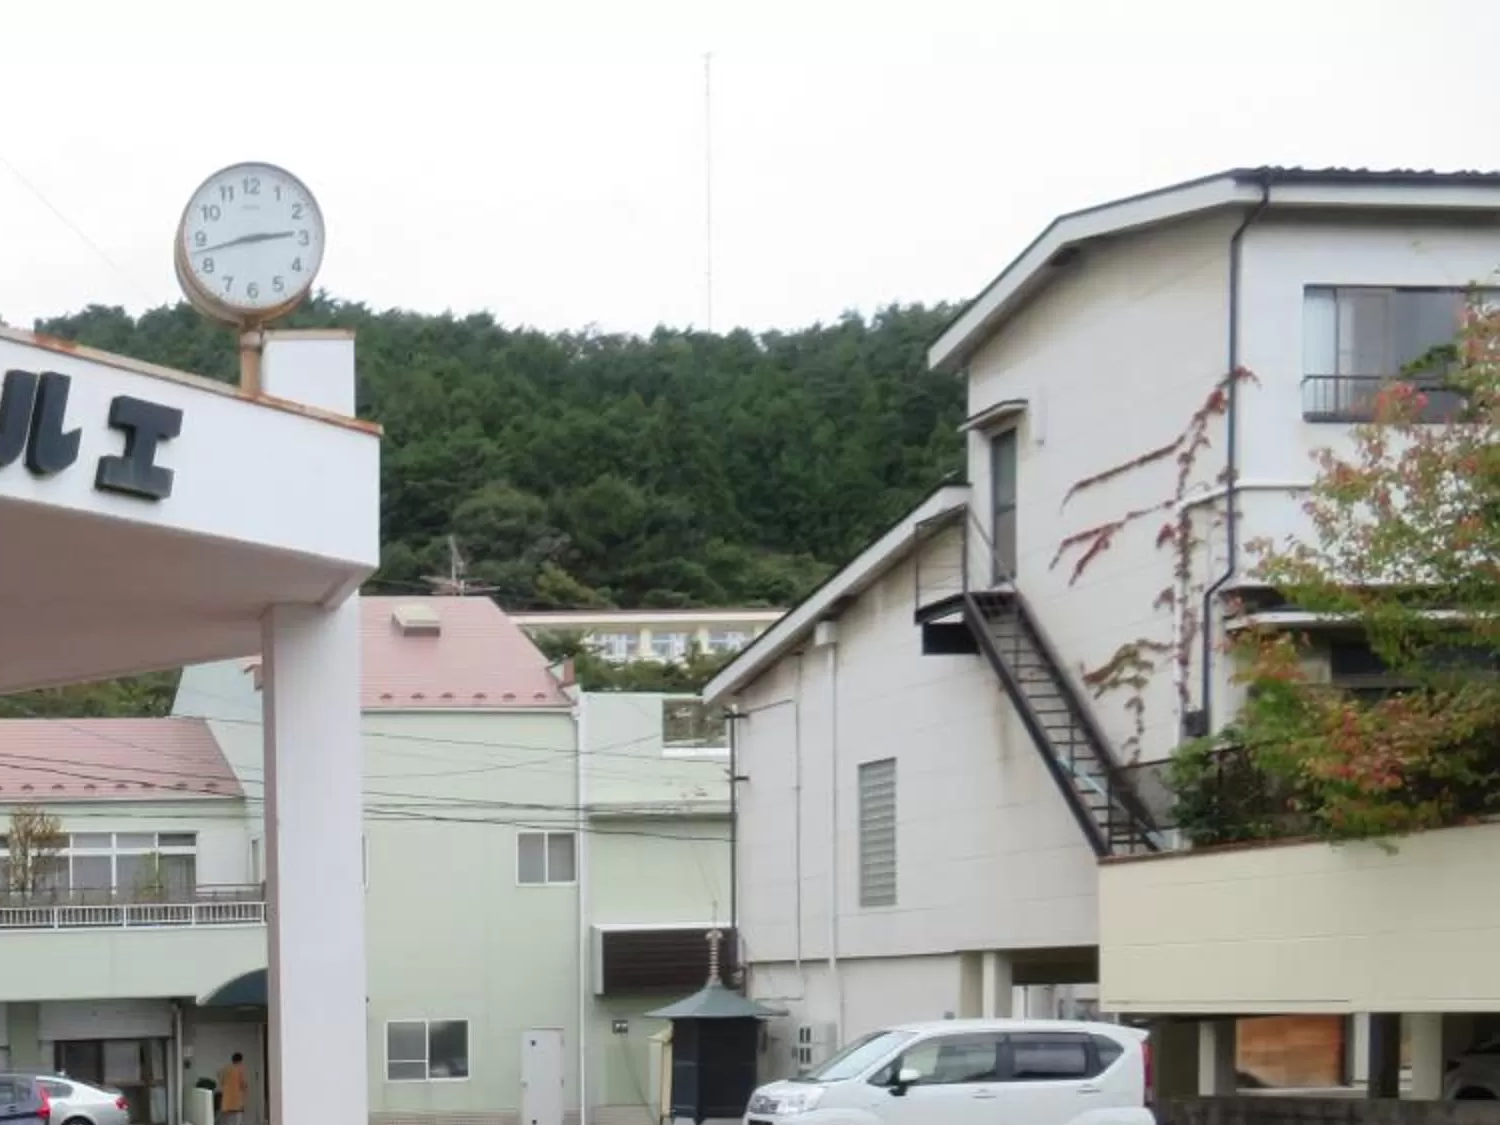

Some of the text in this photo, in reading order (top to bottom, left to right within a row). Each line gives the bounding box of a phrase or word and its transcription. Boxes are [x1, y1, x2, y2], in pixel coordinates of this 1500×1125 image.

[219, 185, 235, 202] 11
[242, 176, 261, 195] 12
[273, 185, 281, 202] 1
[200, 204, 221, 222] 10
[291, 203, 303, 220] 2
[194, 230, 207, 246] 9
[297, 229, 309, 246] 3
[202, 257, 215, 274] 8
[291, 256, 302, 272] 4
[221, 275, 234, 292] 7
[246, 281, 259, 298] 6
[272, 275, 284, 292] 5
